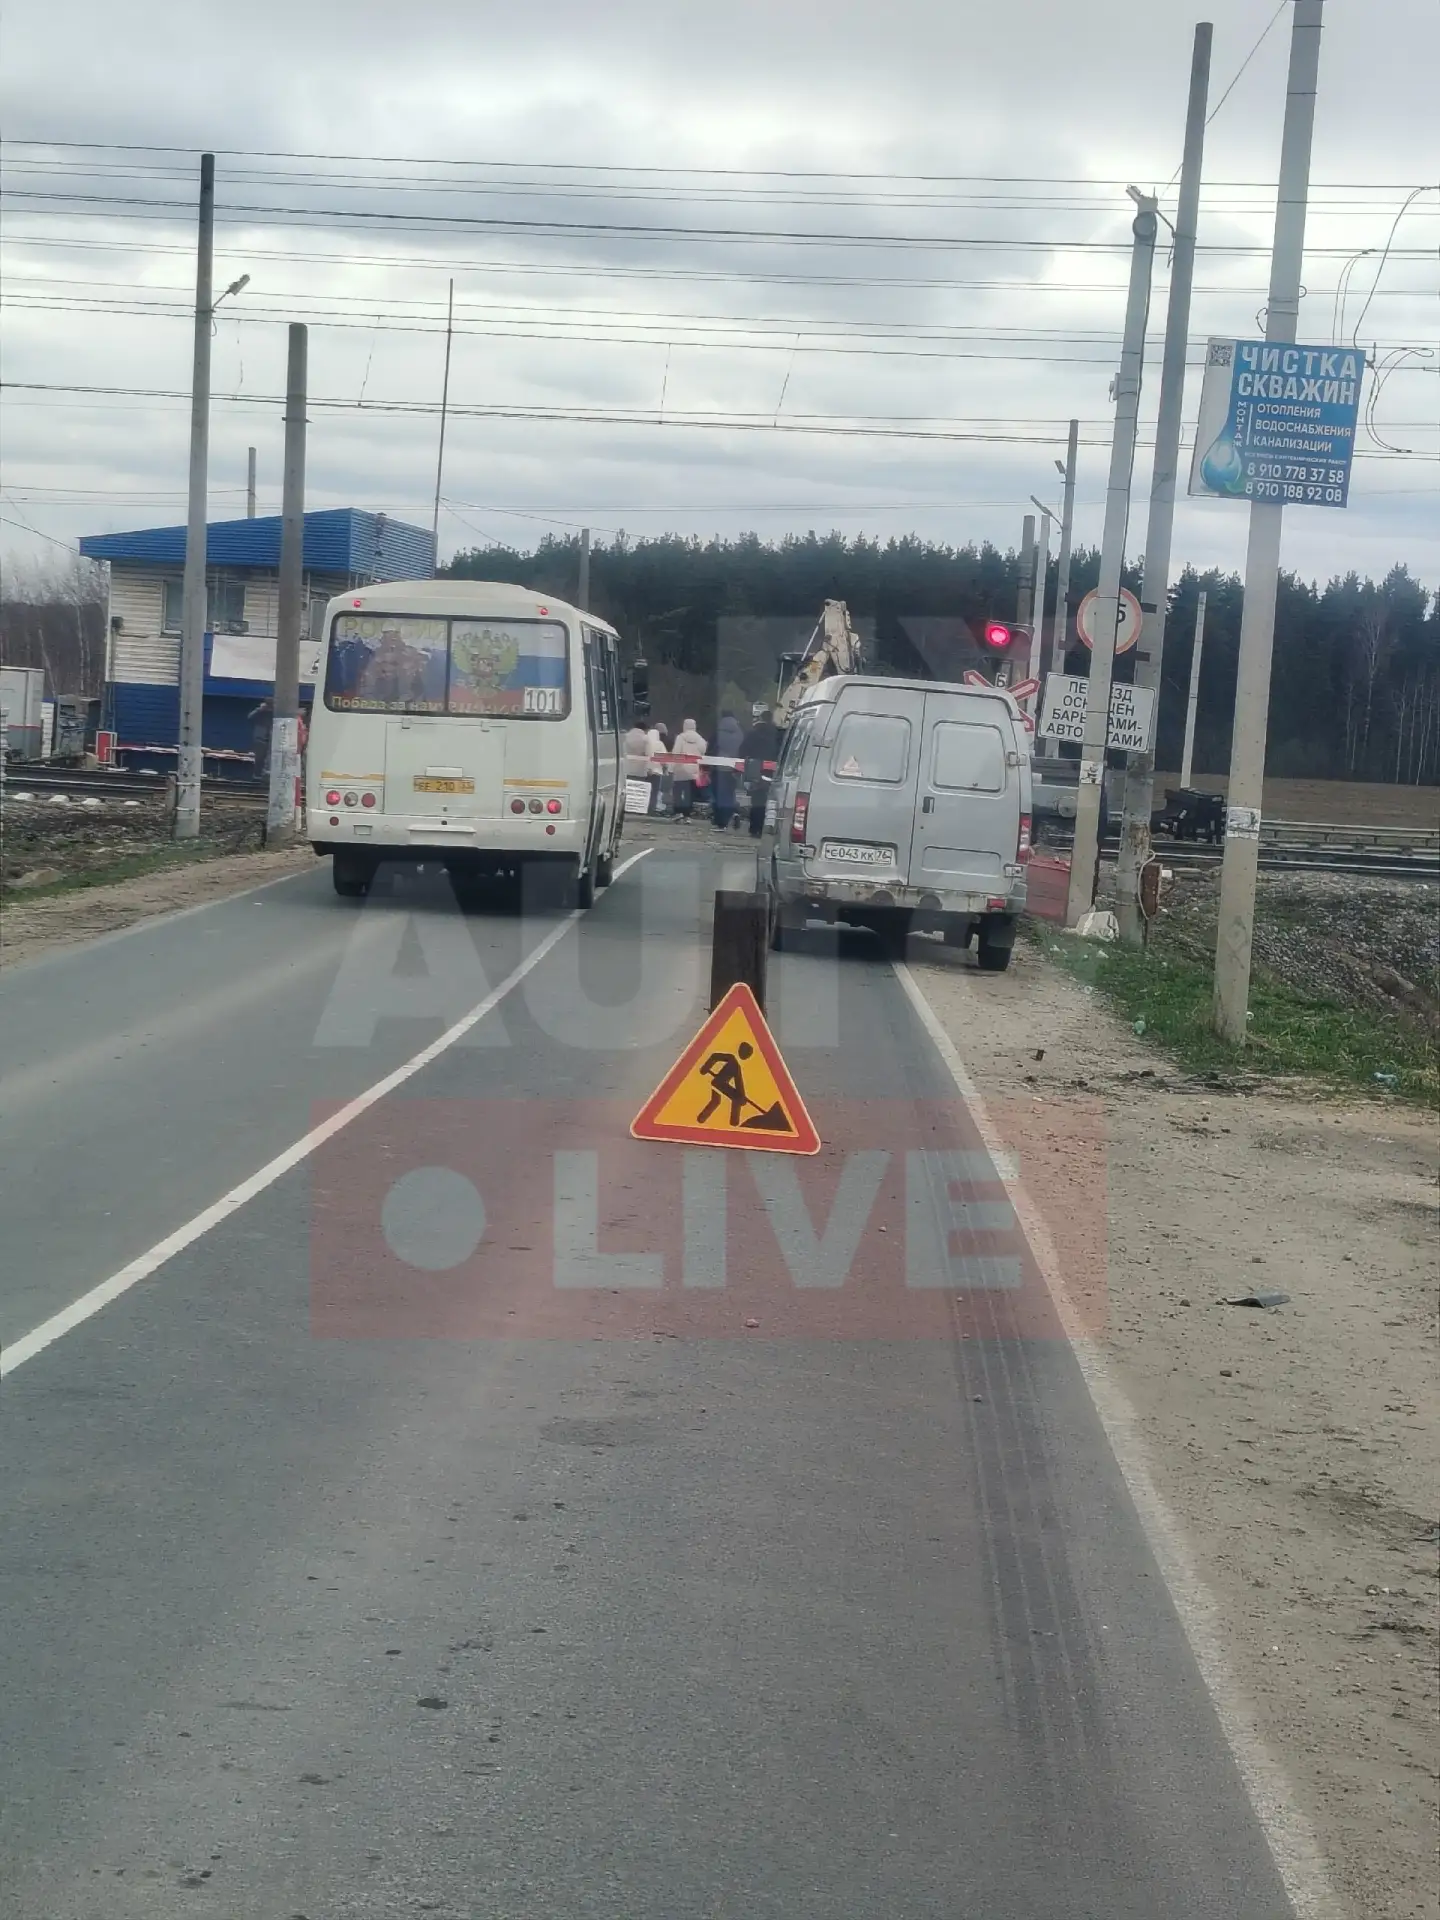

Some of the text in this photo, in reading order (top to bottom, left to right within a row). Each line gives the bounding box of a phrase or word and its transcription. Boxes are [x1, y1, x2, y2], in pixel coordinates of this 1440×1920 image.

[1242, 346, 1357, 379] ЧИСТКА
[1238, 373, 1355, 405] СКВАЖИН
[1257, 403, 1321, 418] ОТОПЛЕНИЯ
[1234, 401, 1247, 448] МОНТАЖ
[1255, 420, 1351, 437] ВОДОСНАБЖЕНИЯ
[1253, 436, 1332, 453] КАНАЛИЗАЦИИ
[1247, 462, 1344, 484] 8 910 778 37 58
[1245, 481, 1342, 502] 8 910 188 92 08
[526, 690, 559, 713] 101
